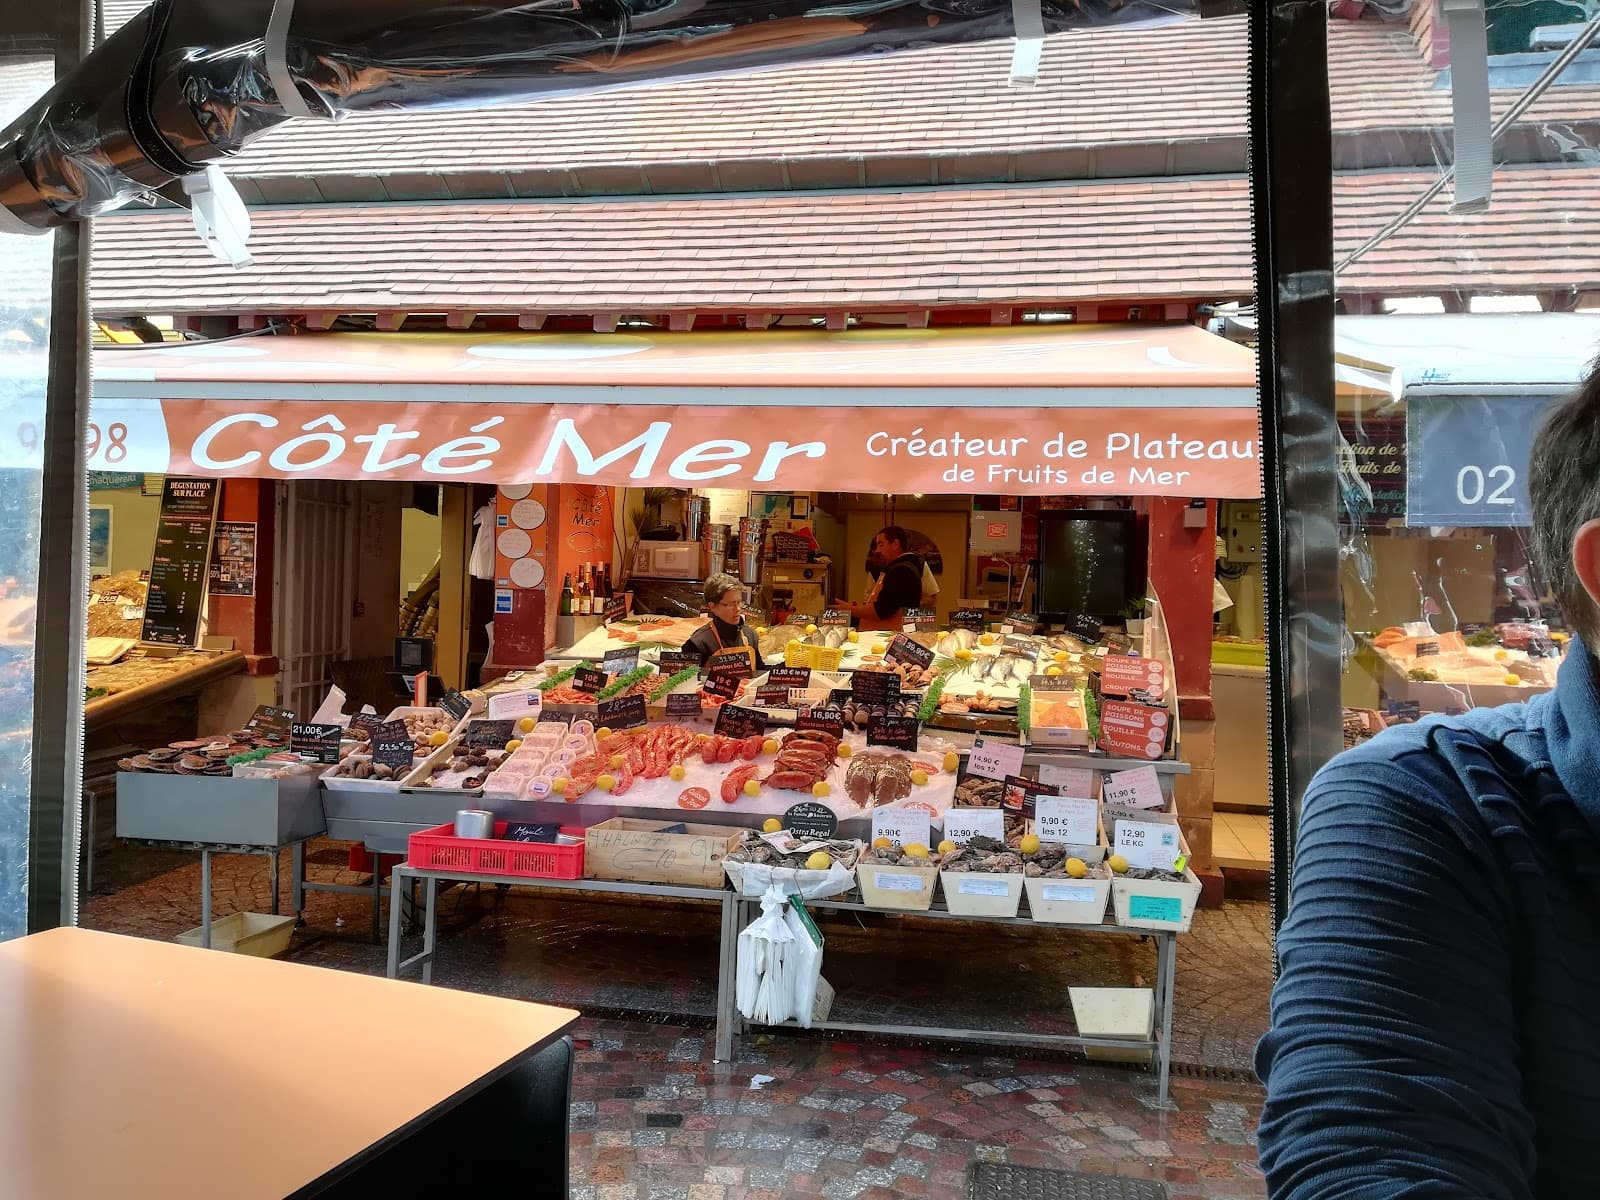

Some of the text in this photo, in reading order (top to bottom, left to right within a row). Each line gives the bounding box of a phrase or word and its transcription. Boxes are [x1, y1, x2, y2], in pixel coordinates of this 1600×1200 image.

[190, 412, 827, 482] Côté Mer
[866, 427, 1261, 461] Créateur de Plateau
[942, 464, 1191, 486] de Fruits de Mer
[1456, 465, 1516, 505] 02
[572, 512, 600, 527] Mer
[1105, 662, 1143, 670] POISSONS
[812, 711, 841, 720] 16,90€
[1106, 704, 1145, 716] SOUPE DE
[1105, 711, 1145, 723] POISSONS
[292, 724, 323, 735] 21,00€
[1100, 738, 1142, 751] COUTONS
[1041, 816, 1069, 826] 9,90 €
[948, 828, 971, 838] 12,90
[1042, 827, 1069, 837] les 12
[1121, 829, 1146, 839] 12,90
[1120, 838, 1144, 848] LE KG
